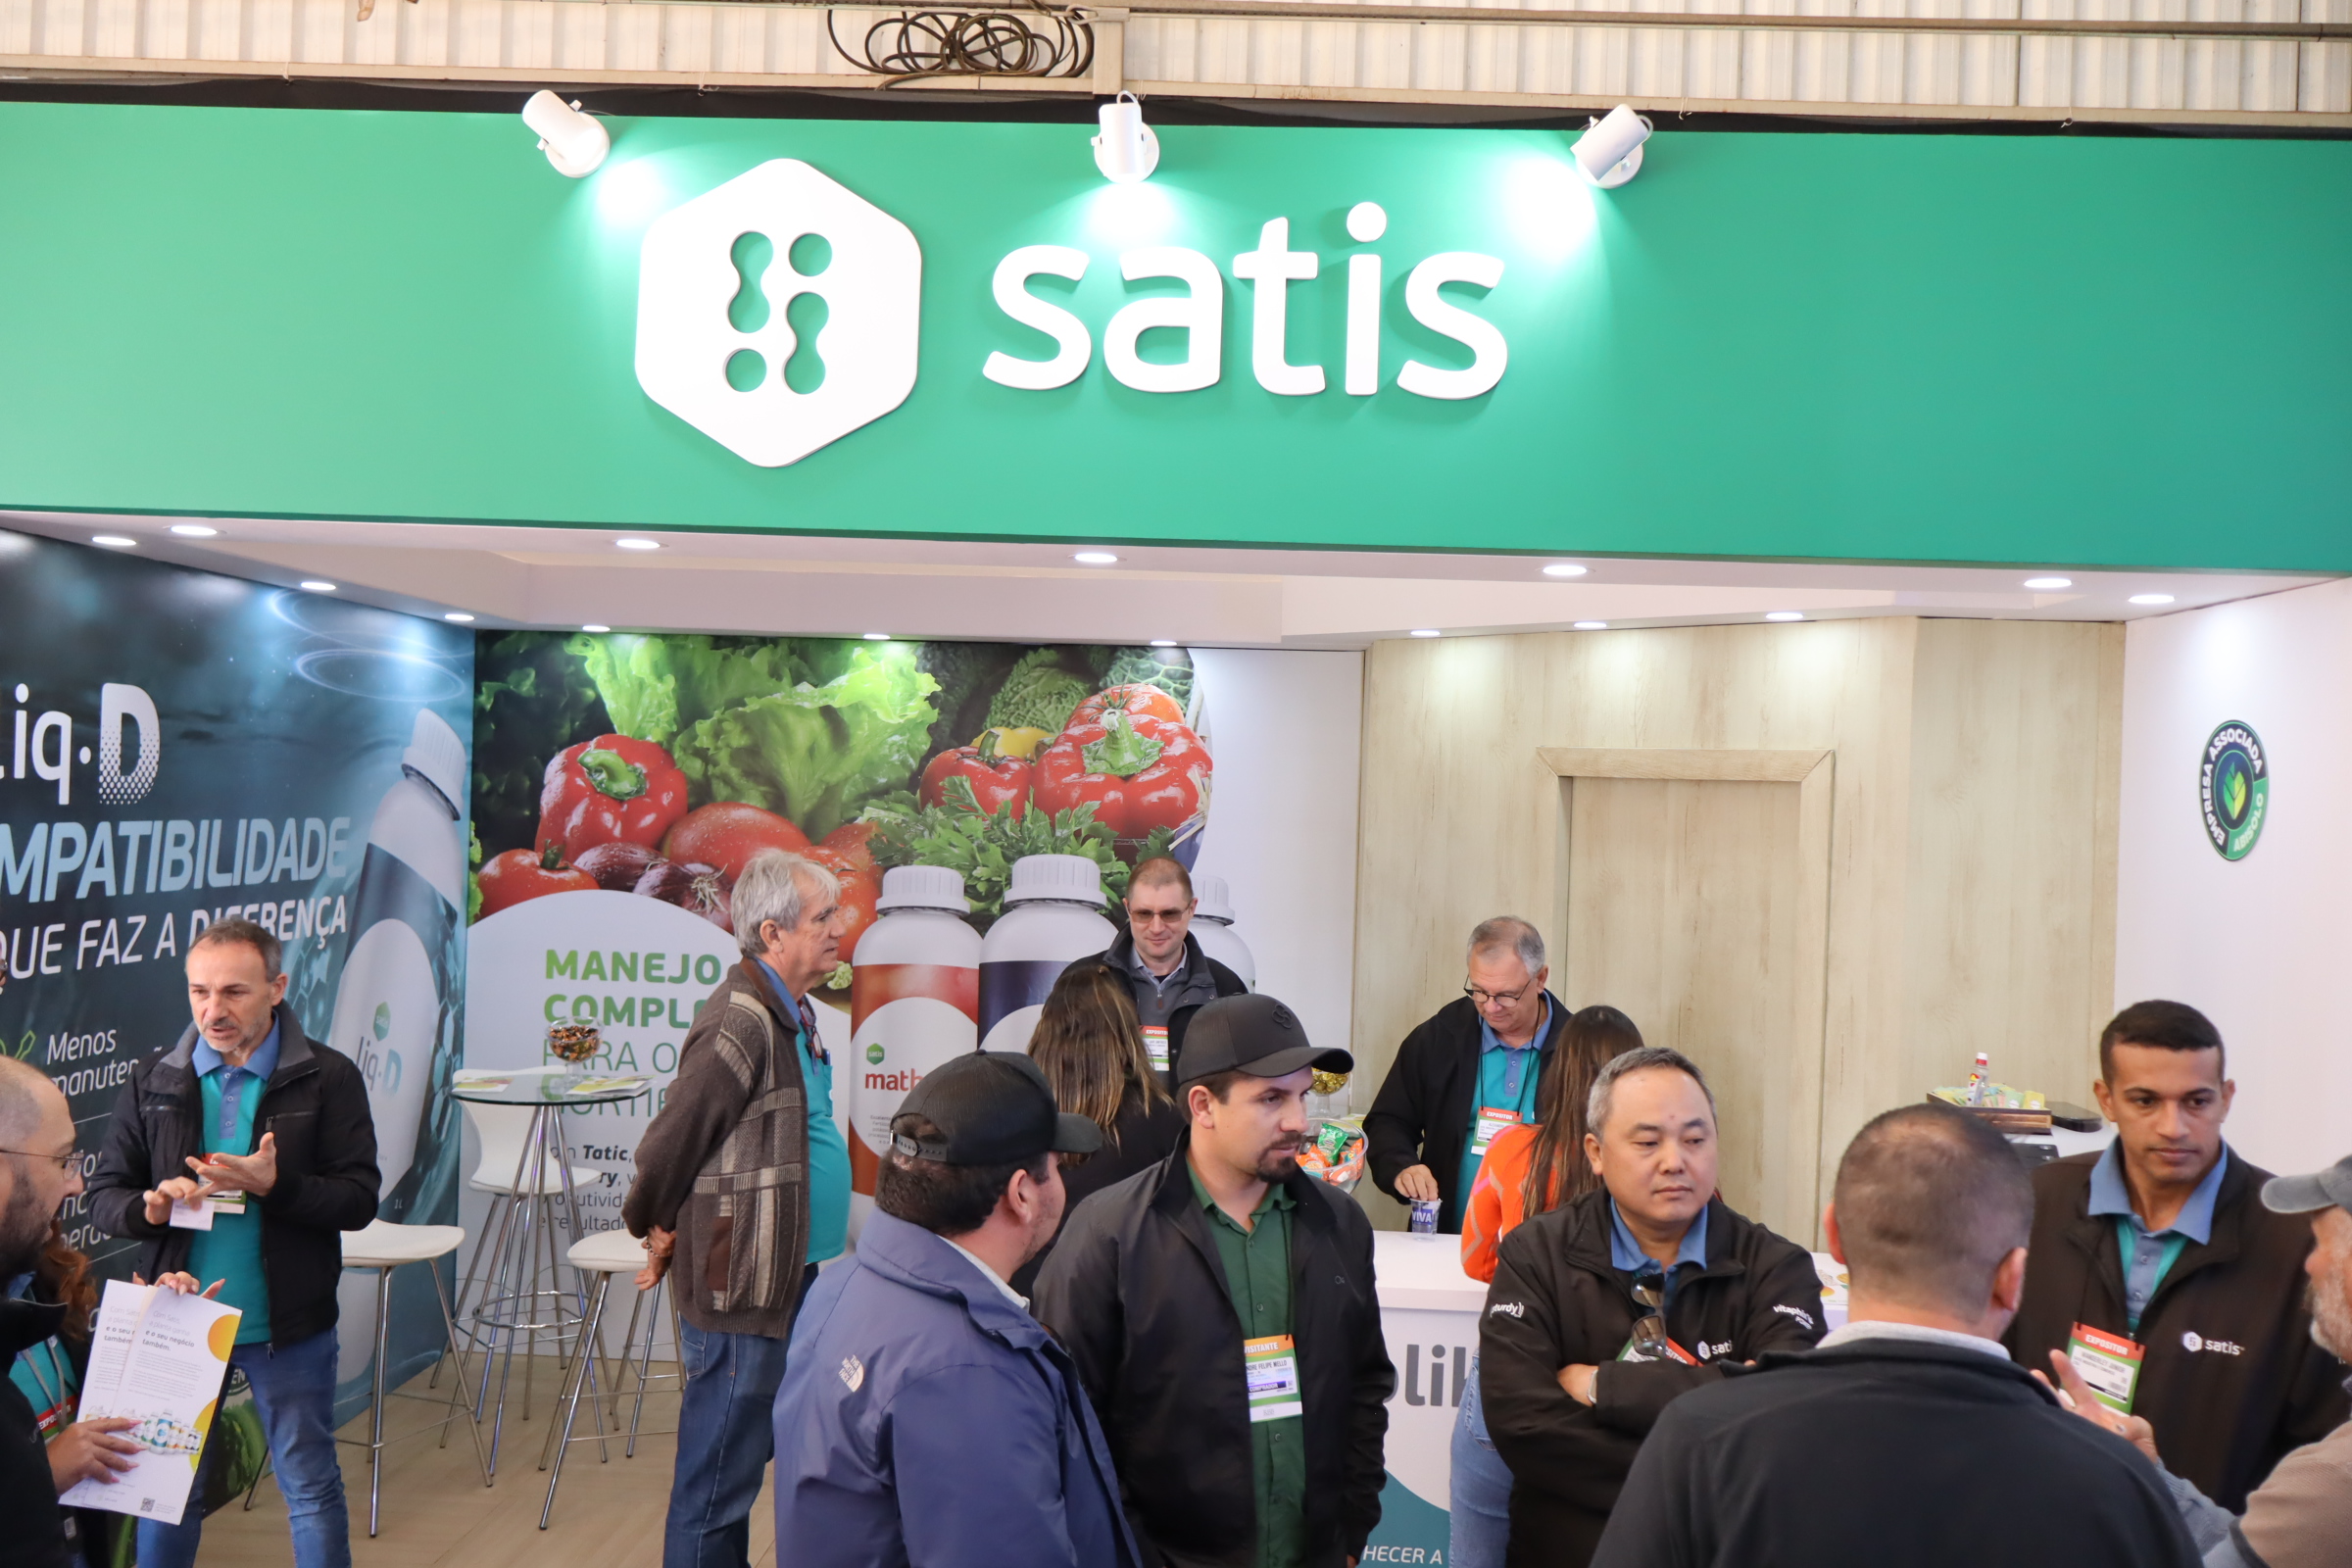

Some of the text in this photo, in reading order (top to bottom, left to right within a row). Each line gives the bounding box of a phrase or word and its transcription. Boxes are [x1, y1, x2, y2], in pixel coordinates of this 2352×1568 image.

[983, 201, 1509, 401] satis
[0, 682, 160, 806] iq.D
[2202, 728, 2263, 846] EMPRESA ASSOCIADA
[2233, 793, 2264, 852] ABISOLO
[0, 817, 351, 904] MPATIBILIDADE
[77, 914, 147, 970] FAZ
[154, 912, 176, 959] A
[189, 895, 347, 950] DERENÇA
[546, 949, 722, 986] MANEJO
[544, 994, 707, 1029] COMPL
[47, 1029, 117, 1065] Menos
[653, 1042, 678, 1074] O
[1486, 1110, 1513, 1120] EXPOSITOR
[583, 1145, 632, 1163] Tatic,
[170, 1335, 195, 1348] negócio
[1711, 1340, 1733, 1355] sati
[2084, 1334, 2129, 1356] EXPOSITOR
[2205, 1340, 2241, 1356] satis
[1429, 1549, 1443, 1565] A
